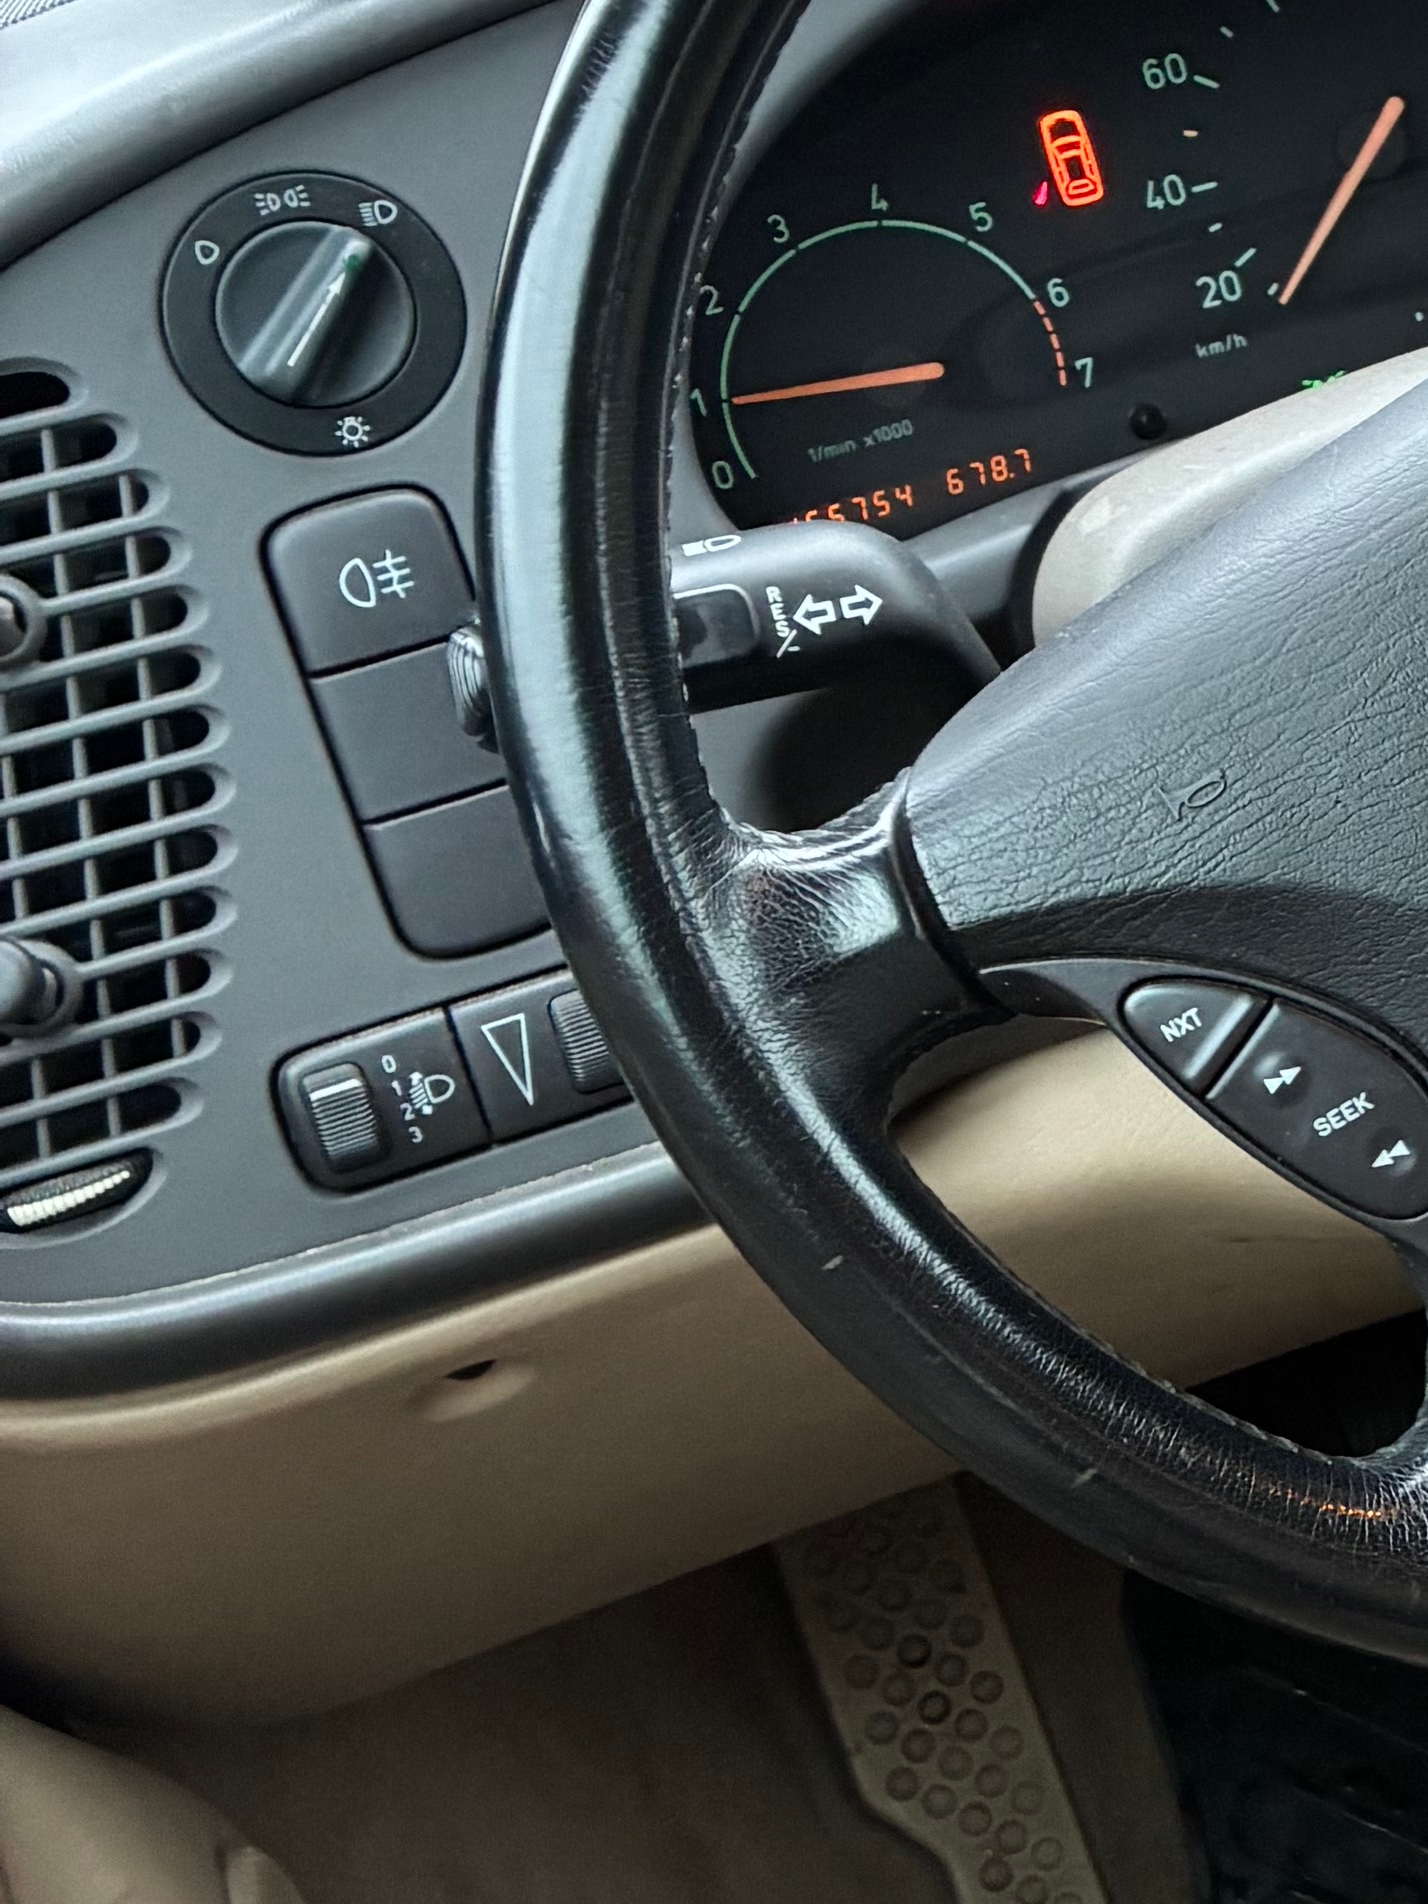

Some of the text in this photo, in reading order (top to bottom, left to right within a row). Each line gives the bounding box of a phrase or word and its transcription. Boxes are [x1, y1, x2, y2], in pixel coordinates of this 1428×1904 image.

[1142, 52, 1188, 90] 60
[870, 183, 888, 211] 4
[1145, 174, 1187, 210] 40
[767, 214, 790, 244] 3
[968, 202, 993, 233] 5
[700, 284, 724, 315] 2
[1046, 278, 1070, 307] 6
[1195, 270, 1242, 309] 20
[1195, 334, 1248, 359] km/h
[1075, 357, 1094, 388] 7
[689, 388, 708, 417] 1
[808, 419, 914, 464] 1/min x1000
[711, 460, 735, 489] 0
[945, 448, 1032, 496] 678.7
[1159, 1007, 1203, 1043] NXT
[381, 1054, 397, 1073] 0
[400, 1102, 416, 1121] 2
[1313, 1091, 1376, 1137] SEEK
[408, 1126, 423, 1143] 3
